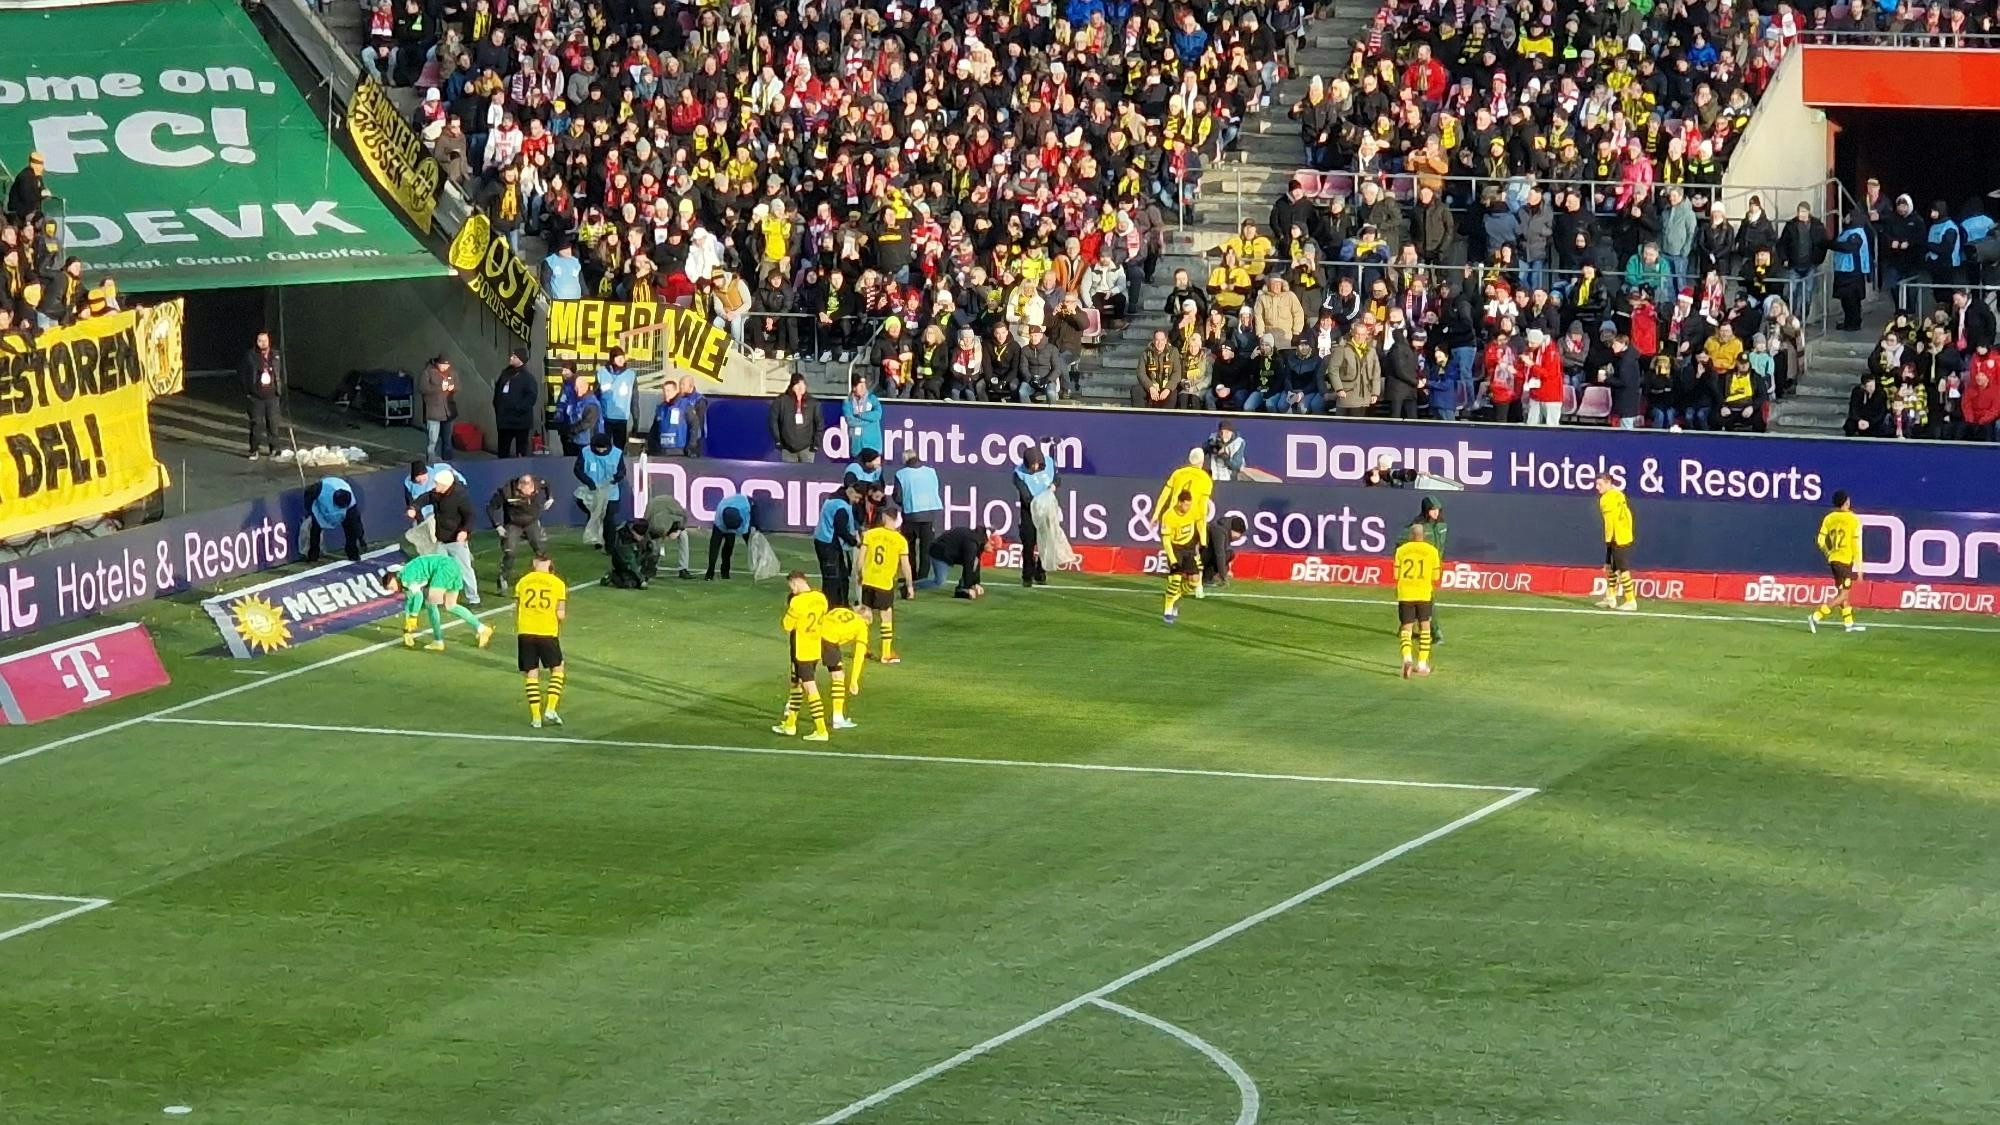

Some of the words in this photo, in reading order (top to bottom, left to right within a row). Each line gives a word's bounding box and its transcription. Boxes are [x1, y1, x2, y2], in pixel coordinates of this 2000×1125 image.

[159, 66, 275, 94] on,
[29, 107, 256, 174] FC!
[55, 201, 366, 248] DEVK
[176, 252, 260, 267] Getan.
[266, 246, 387, 263] Geholfen.
[486, 235, 539, 318] OST
[5, 414, 107, 498] DFL!
[822, 416, 1082, 468] drint.com
[1286, 434, 1493, 485] Dorint
[1511, 452, 1627, 492] Hotels
[1640, 458, 1664, 494] &
[1681, 459, 1822, 501] Resorts
[944, 485, 1108, 540] Hols
[57, 548, 157, 617] Hotels
[156, 540, 176, 588] &
[184, 516, 288, 582] Resorts
[874, 545, 885, 566] 6
[1403, 558, 1424, 579] 21
[281, 564, 405, 622] MERKU
[525, 588, 551, 610] 25
[1590, 577, 1684, 600] DTOUR
